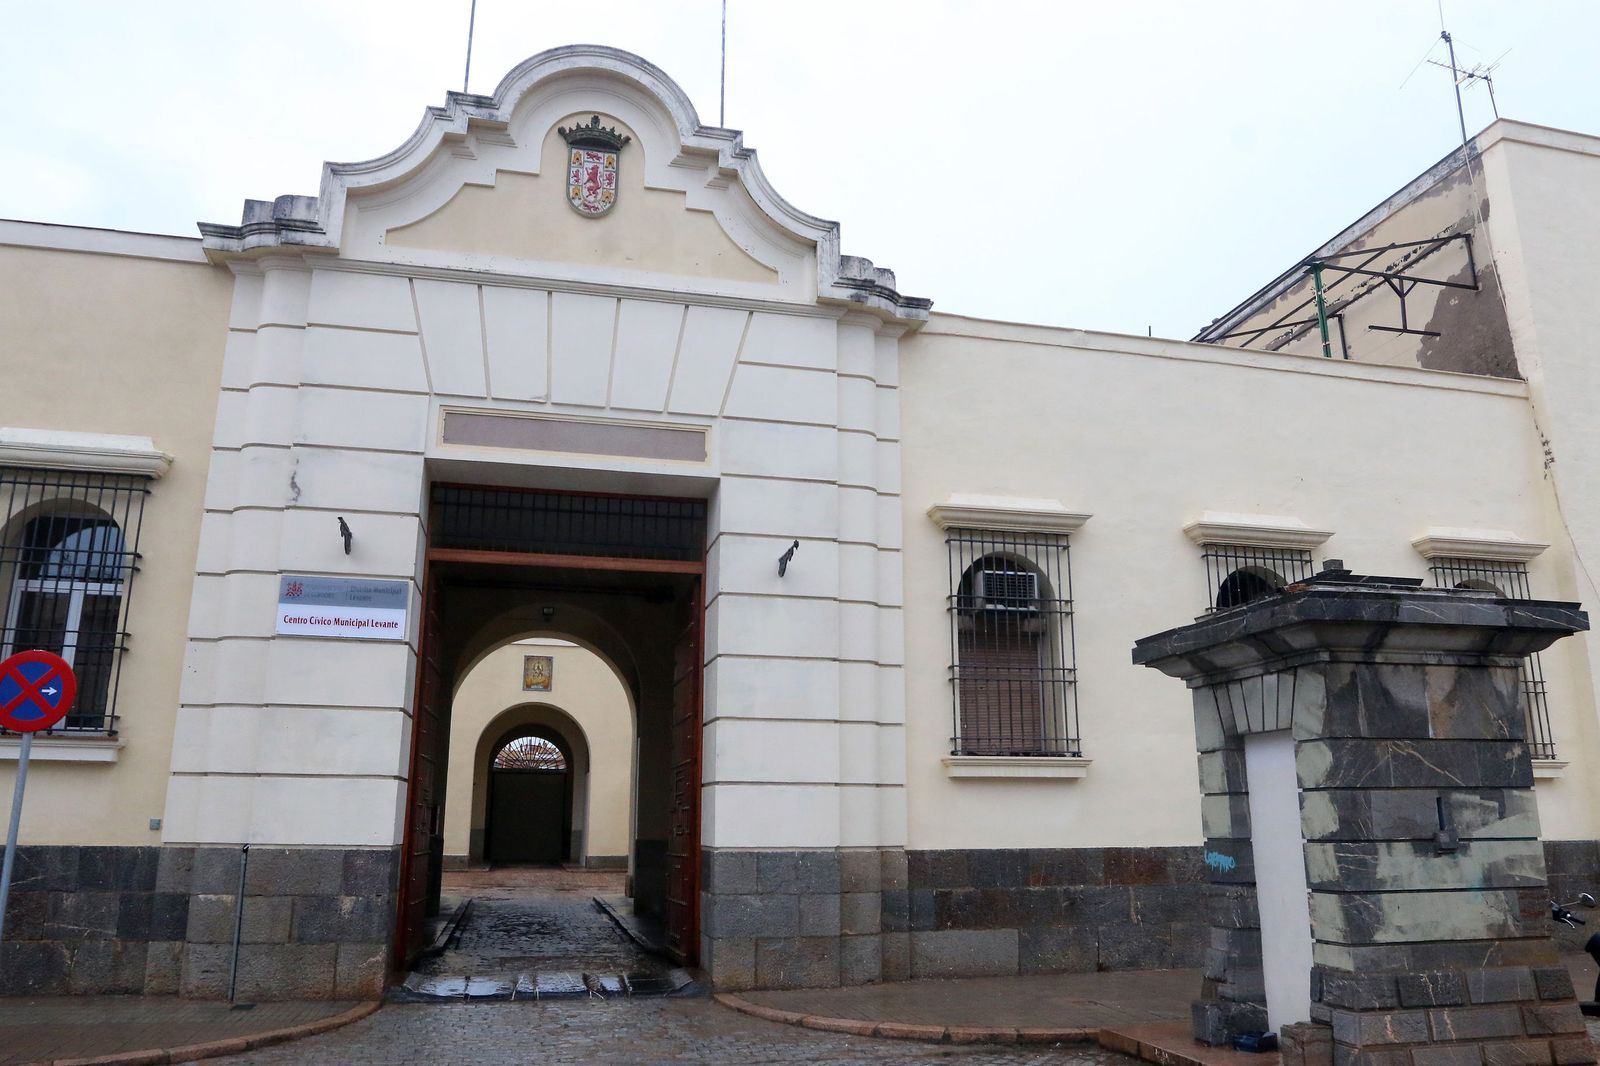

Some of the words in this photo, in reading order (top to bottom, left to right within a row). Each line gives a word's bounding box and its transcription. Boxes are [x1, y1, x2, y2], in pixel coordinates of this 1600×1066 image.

[283, 614, 308, 625] Centro
[309, 615, 332, 626] Cívico
[333, 617, 369, 630] Municipal
[371, 619, 399, 629] Levante
